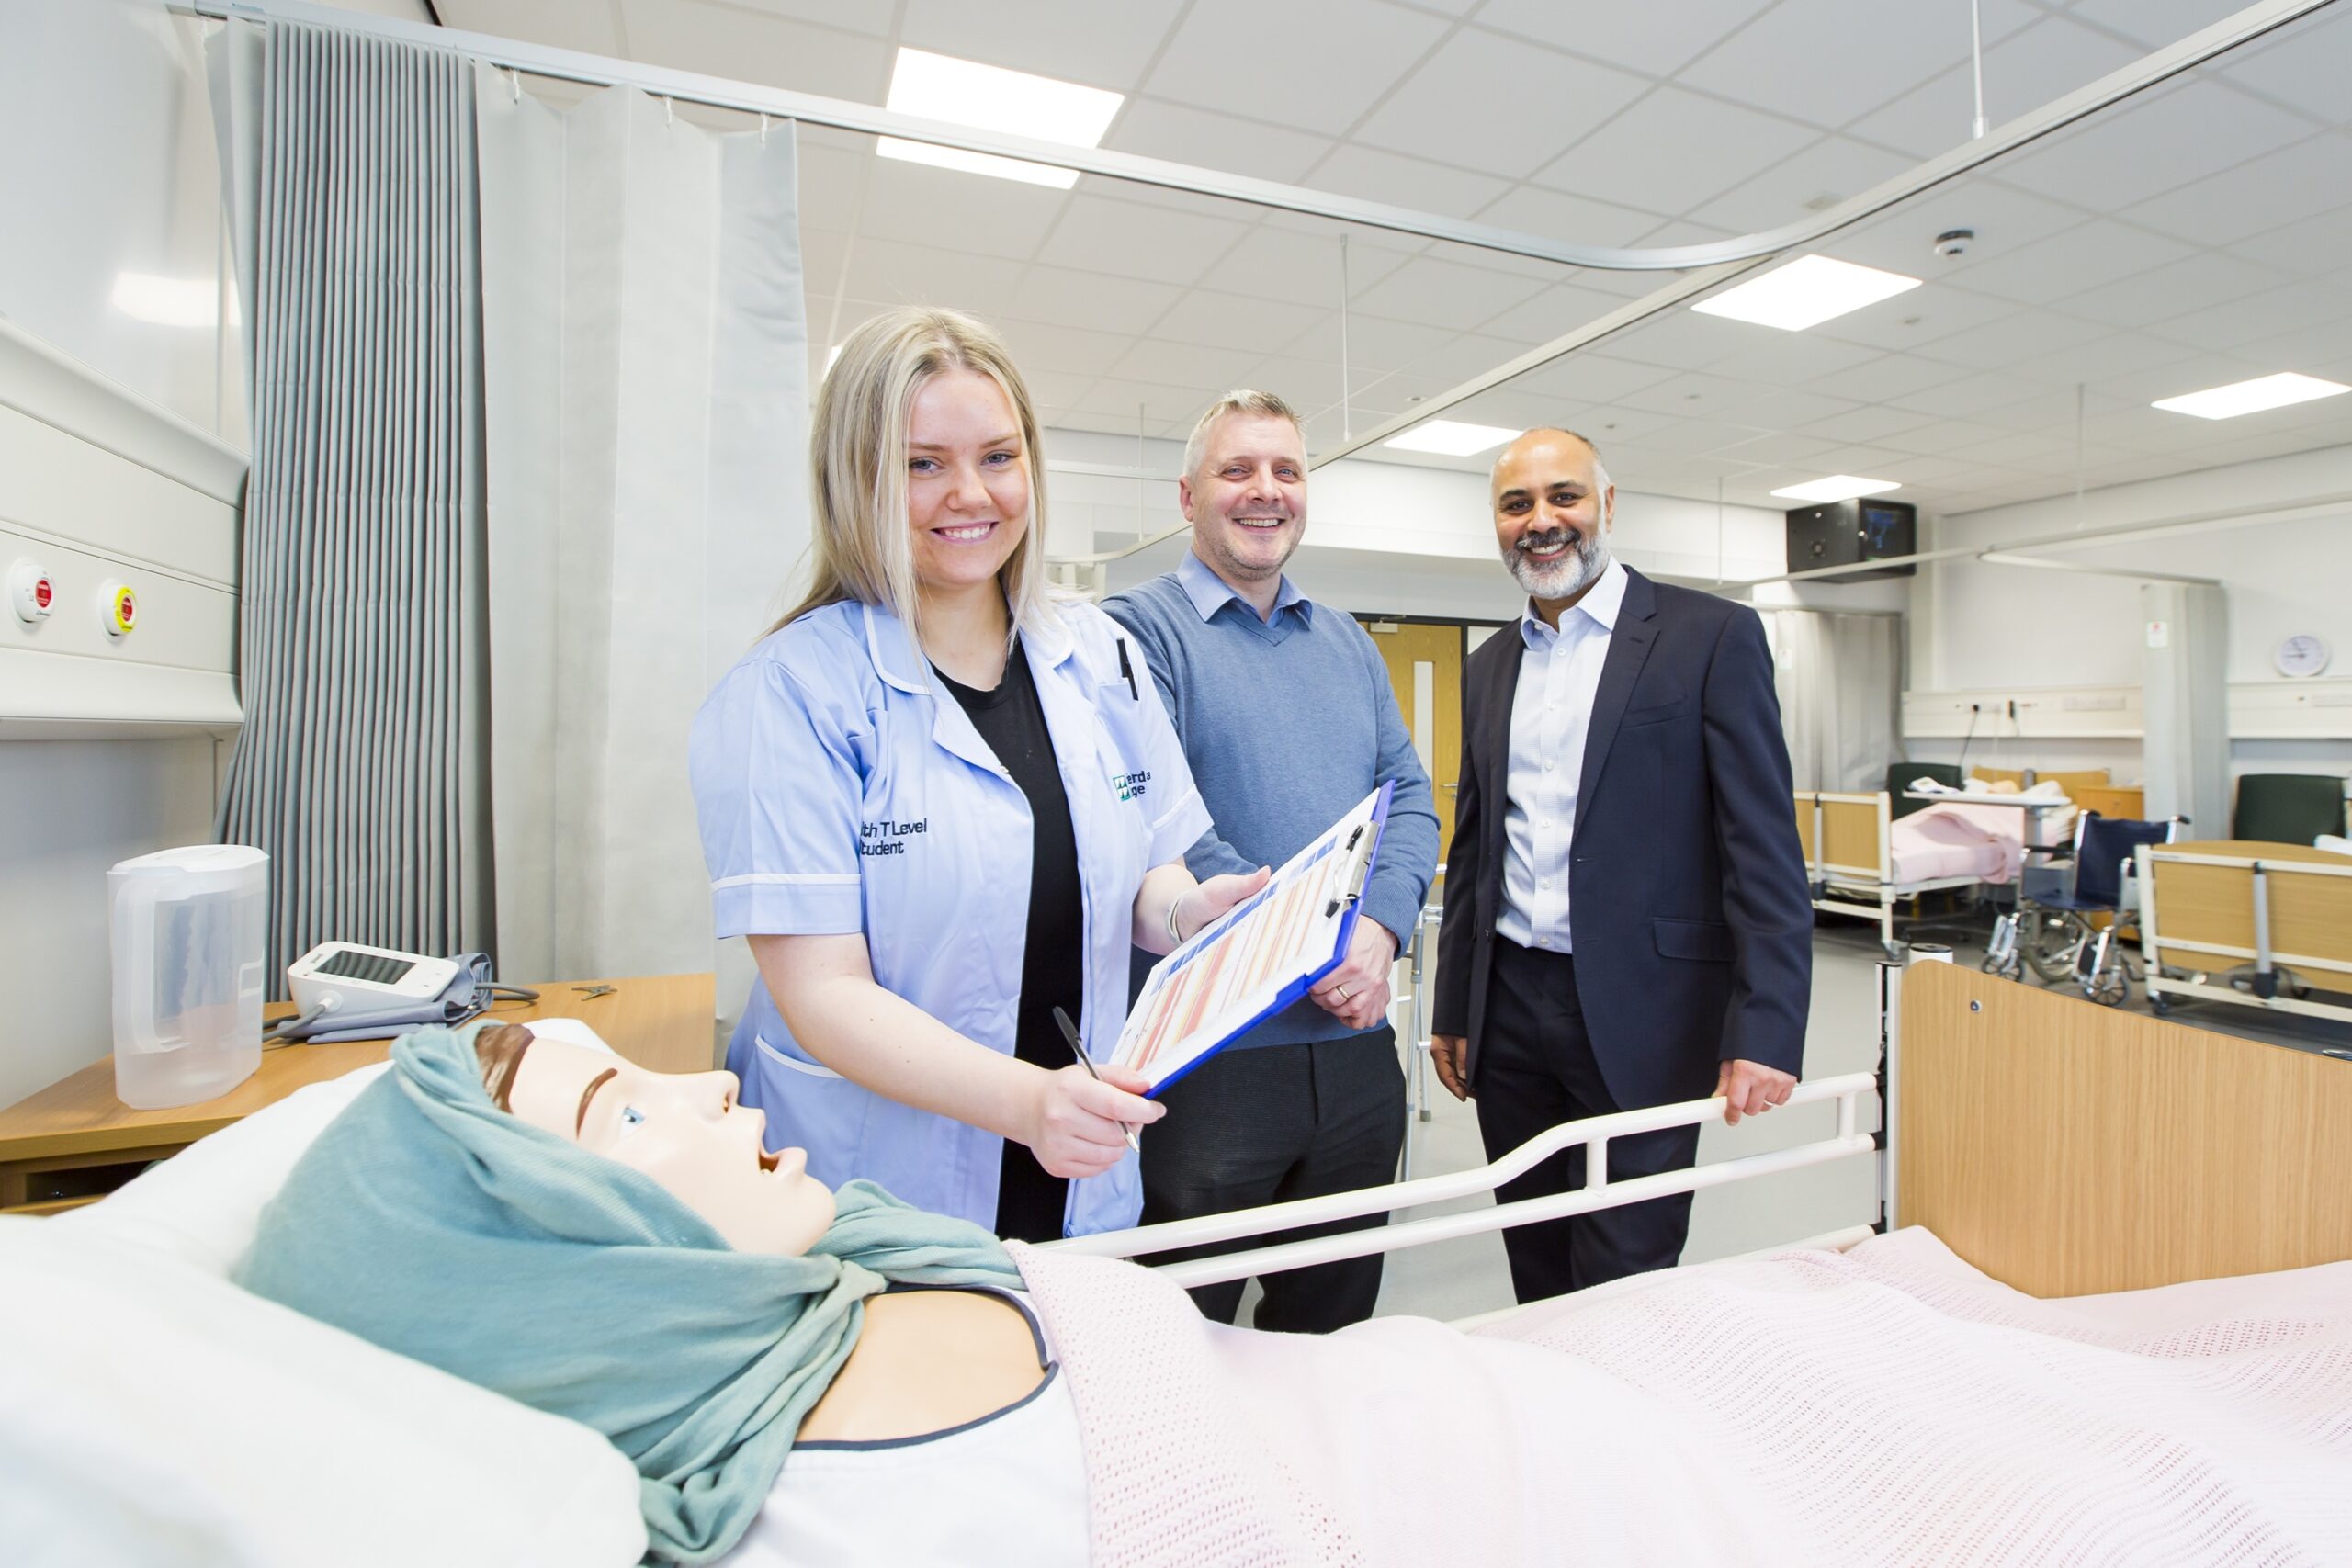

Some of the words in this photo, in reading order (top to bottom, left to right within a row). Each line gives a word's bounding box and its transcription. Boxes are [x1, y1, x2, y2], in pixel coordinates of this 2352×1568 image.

[861, 820, 878, 838] lth
[880, 821, 891, 837] T
[891, 818, 927, 836] Level
[860, 840, 904, 856] tudent
